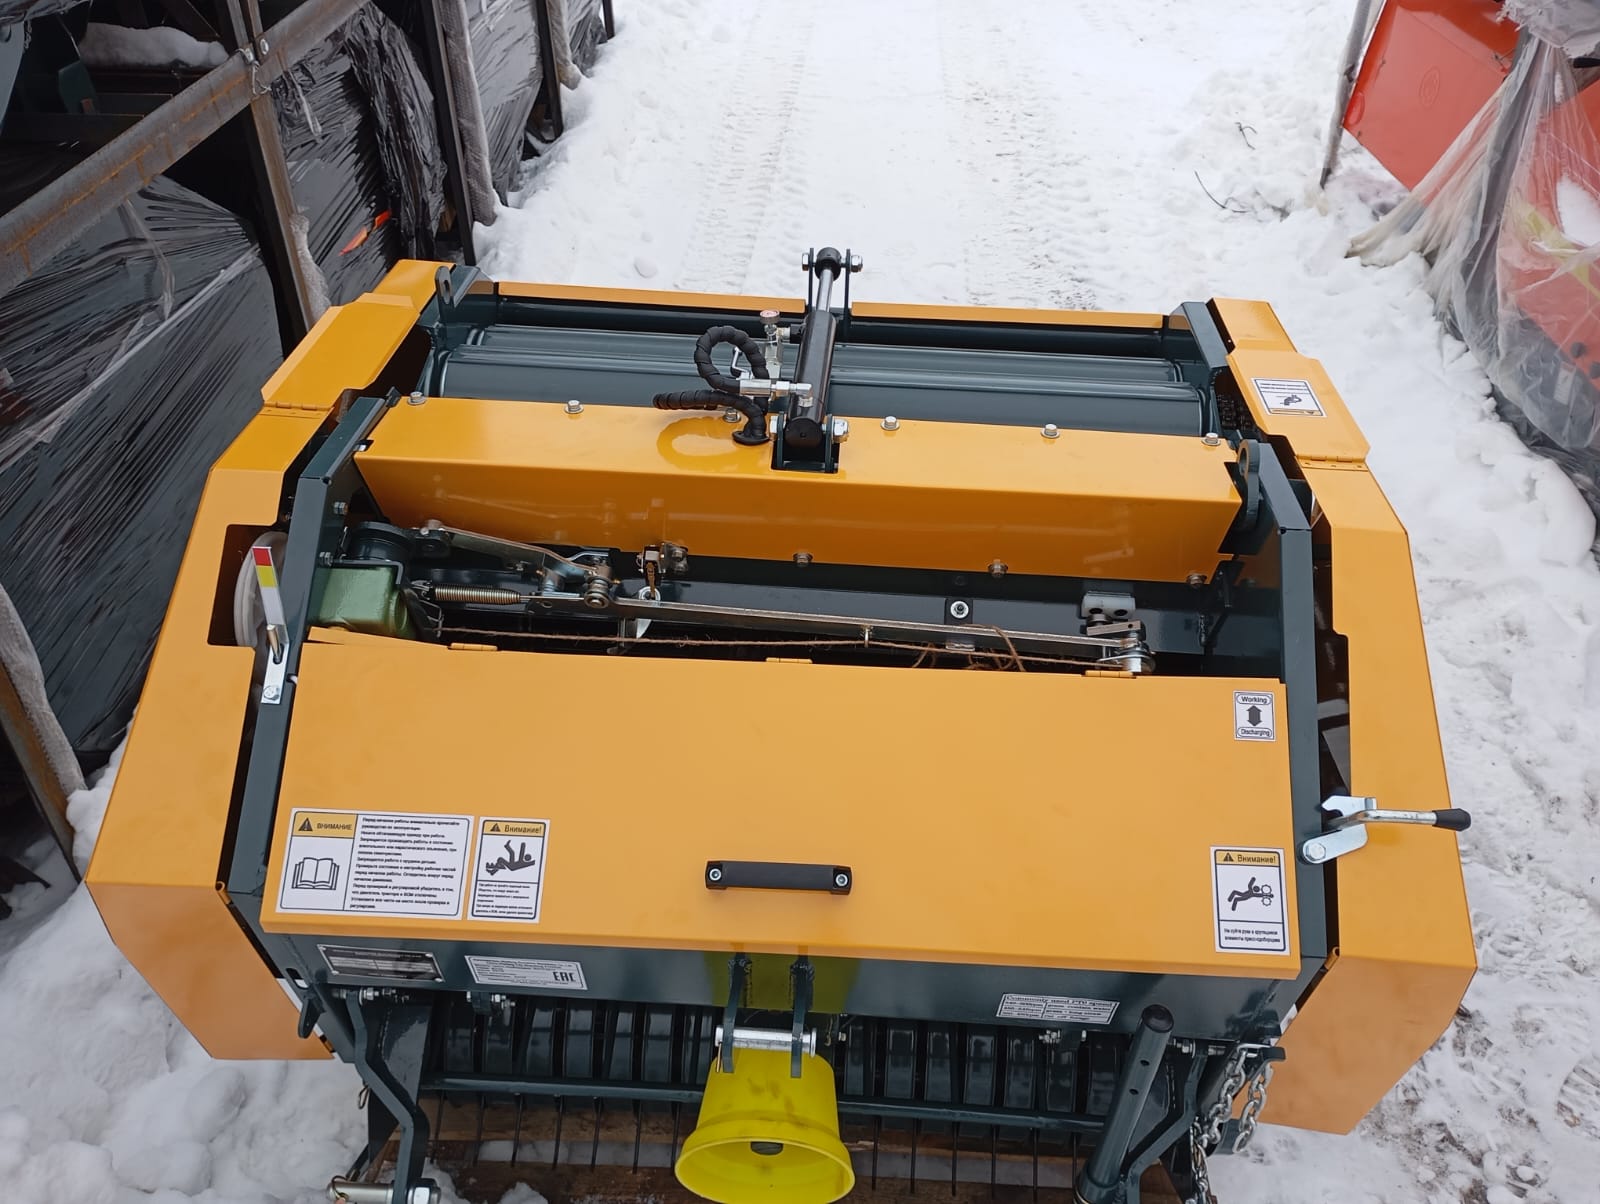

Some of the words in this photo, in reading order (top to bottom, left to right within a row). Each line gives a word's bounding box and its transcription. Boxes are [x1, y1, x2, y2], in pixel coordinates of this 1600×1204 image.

[1241, 696, 1268, 704] Working
[316, 822, 353, 831] ВНИМАНИЕ
[504, 824, 542, 833] Внимание!
[1237, 854, 1276, 863] Внимание!
